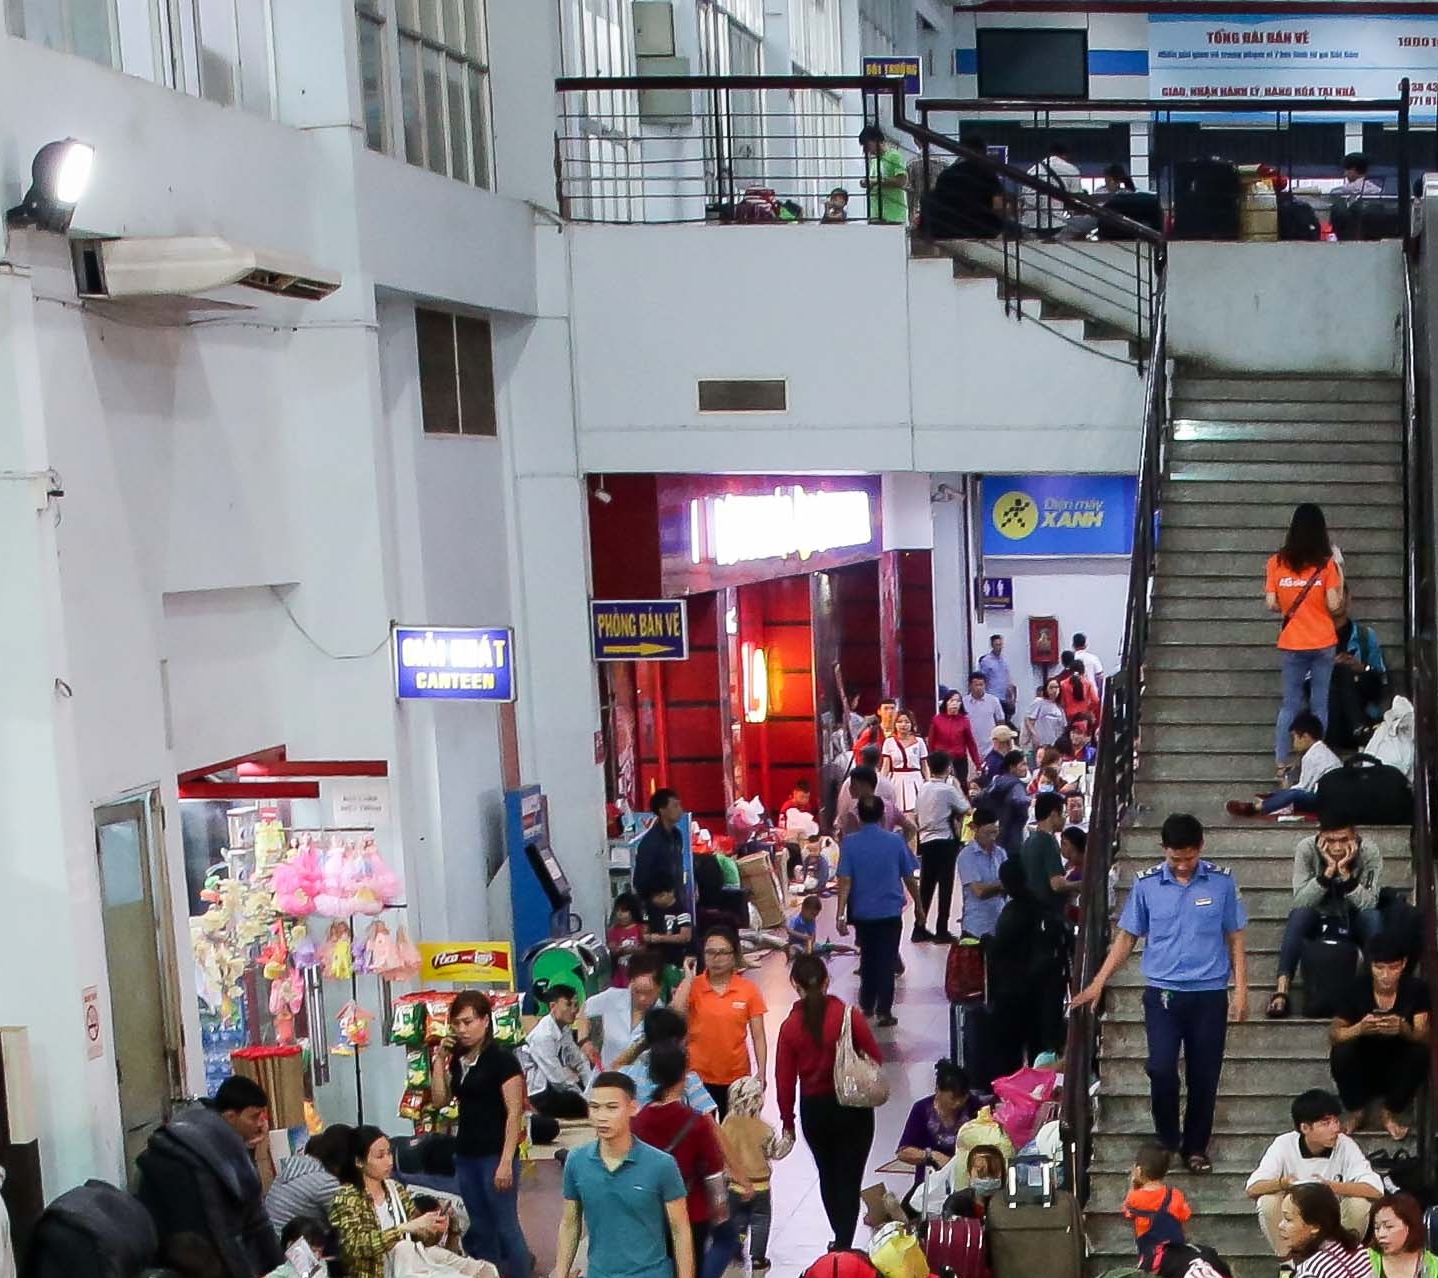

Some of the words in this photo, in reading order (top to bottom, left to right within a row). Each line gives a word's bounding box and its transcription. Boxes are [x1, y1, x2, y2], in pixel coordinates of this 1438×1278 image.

[1042, 510, 1105, 528] XANH
[598, 607, 637, 638] PHÒNG
[639, 605, 664, 637] BÁN
[665, 605, 681, 638] VÉ
[416, 672, 496, 690] CANTEEN
